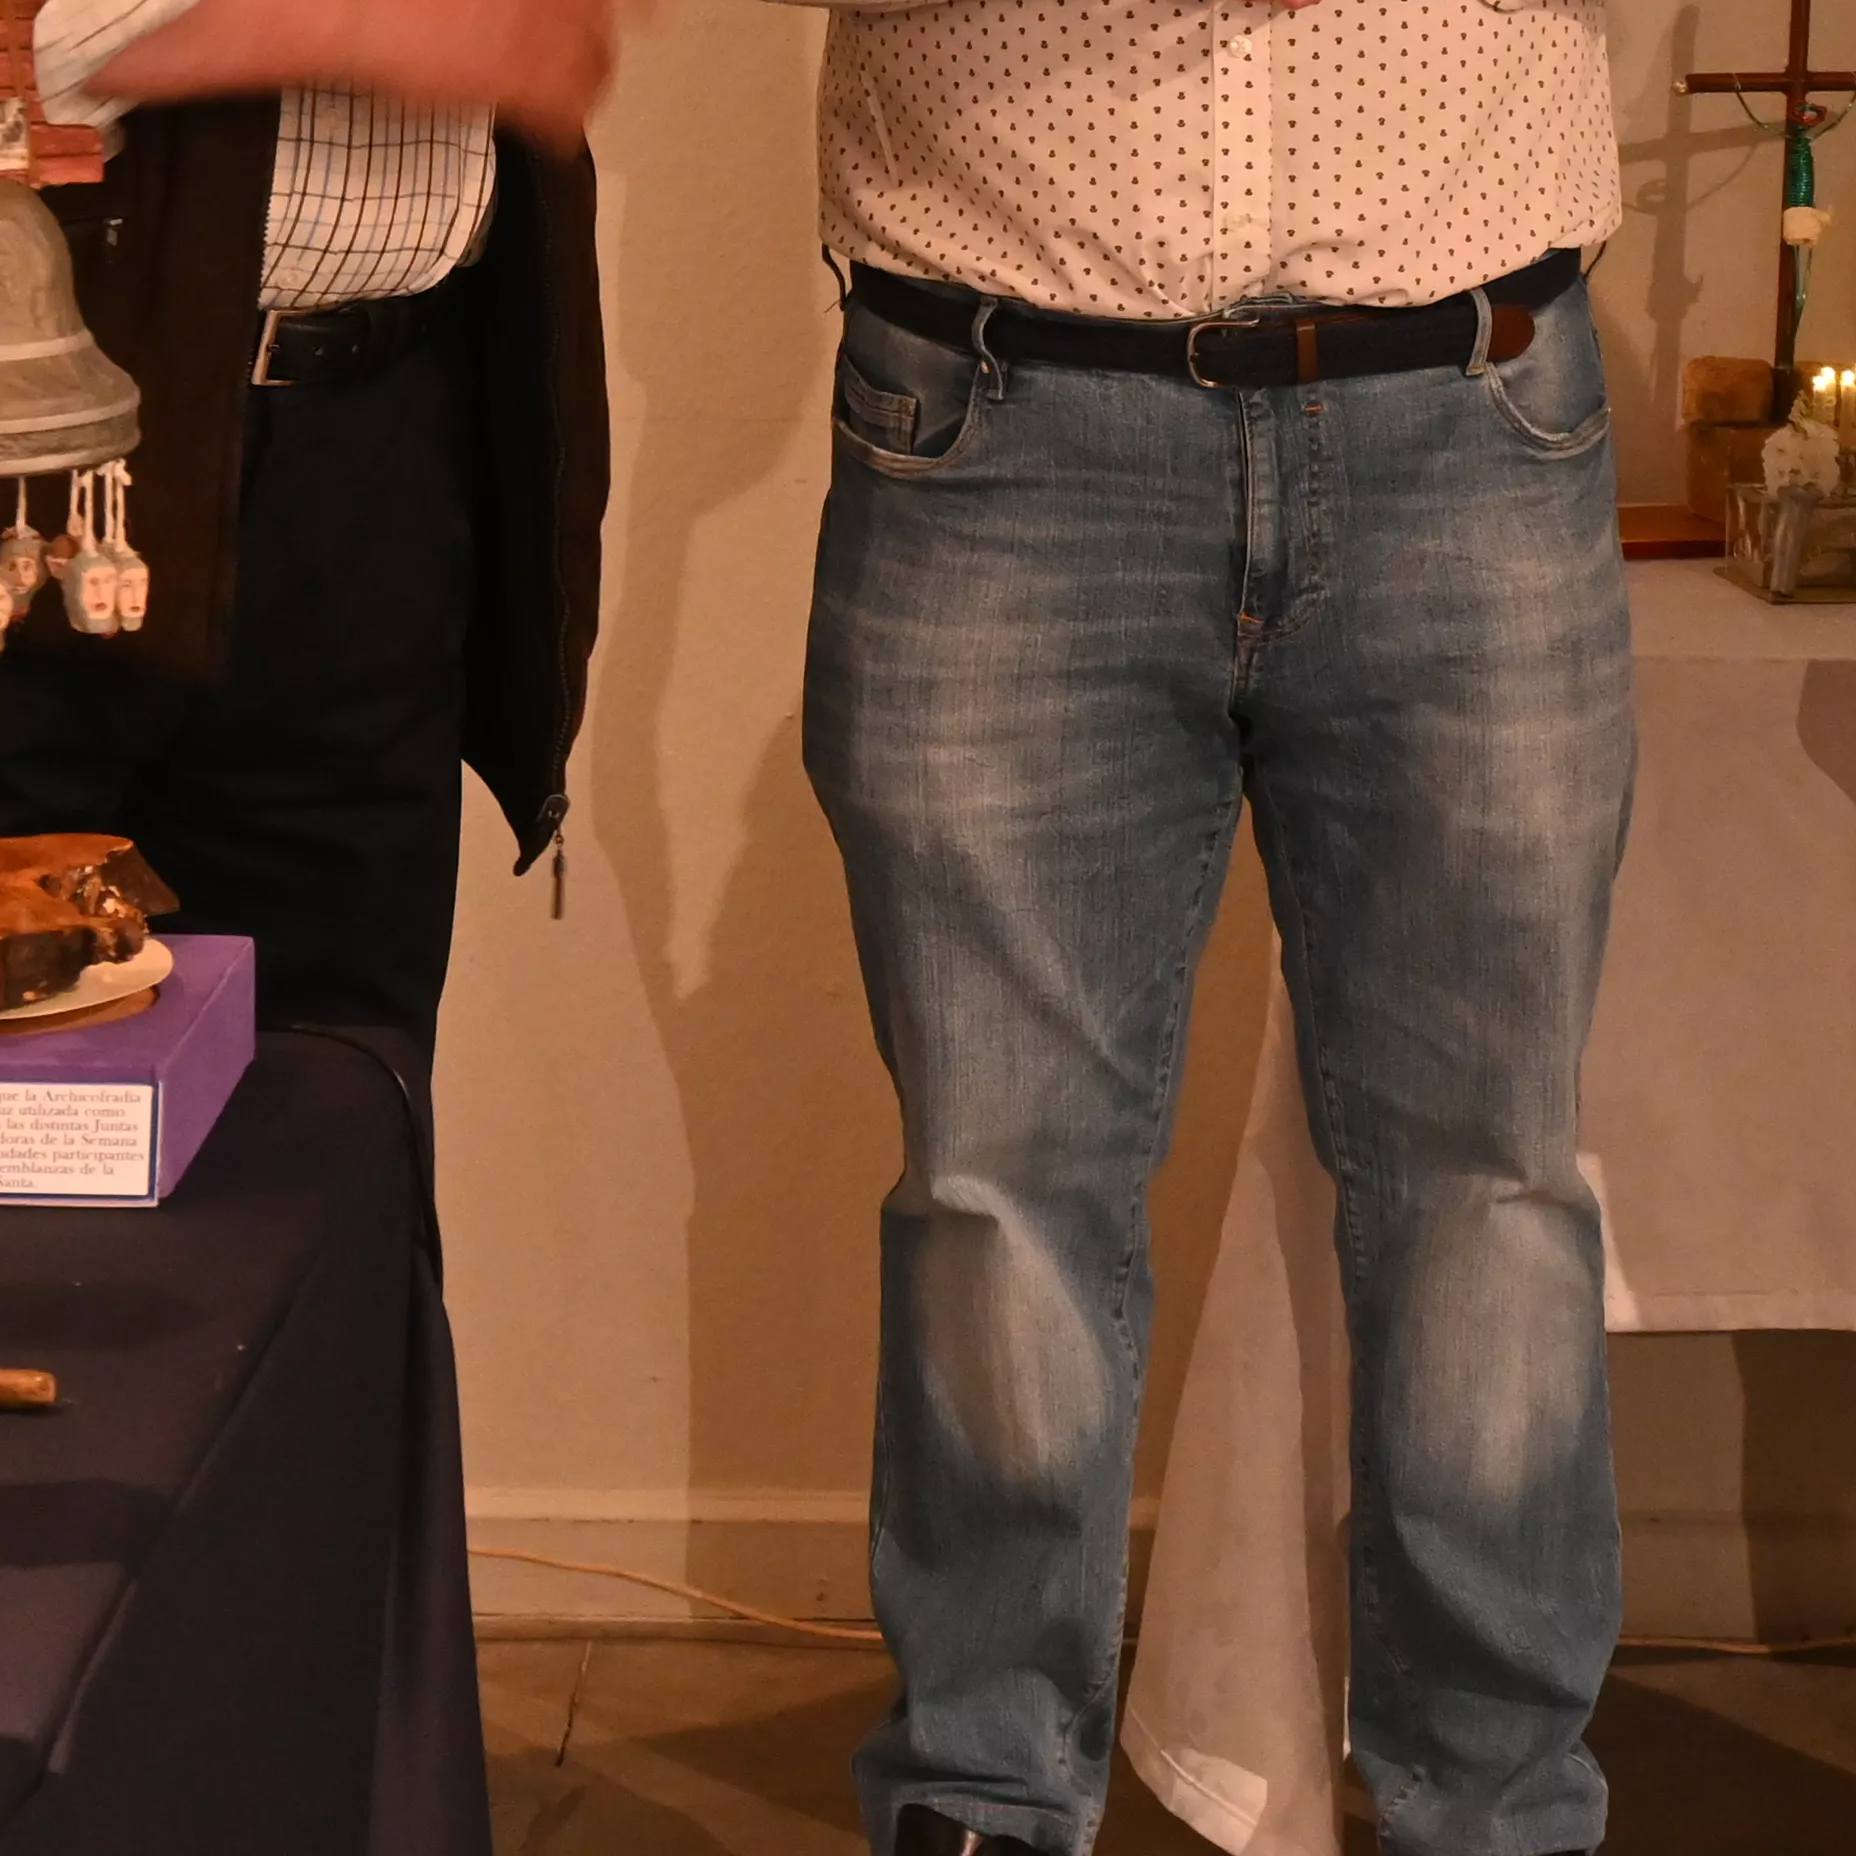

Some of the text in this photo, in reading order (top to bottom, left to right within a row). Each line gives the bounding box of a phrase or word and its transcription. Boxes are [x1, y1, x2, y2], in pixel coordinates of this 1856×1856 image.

[25, 1089, 36, 1102] la
[19, 1104, 79, 1116] utilizada
[84, 1108, 126, 1117] como
[7, 1118, 25, 1130] las
[30, 1119, 89, 1131] distintas
[92, 1119, 139, 1133] Juntas
[40, 1134, 58, 1145] de
[64, 1134, 75, 1146] la
[81, 1134, 138, 1147] Semana
[52, 1150, 145, 1163] participantes
[80, 1163, 96, 1175] de
[103, 1163, 114, 1176] la
